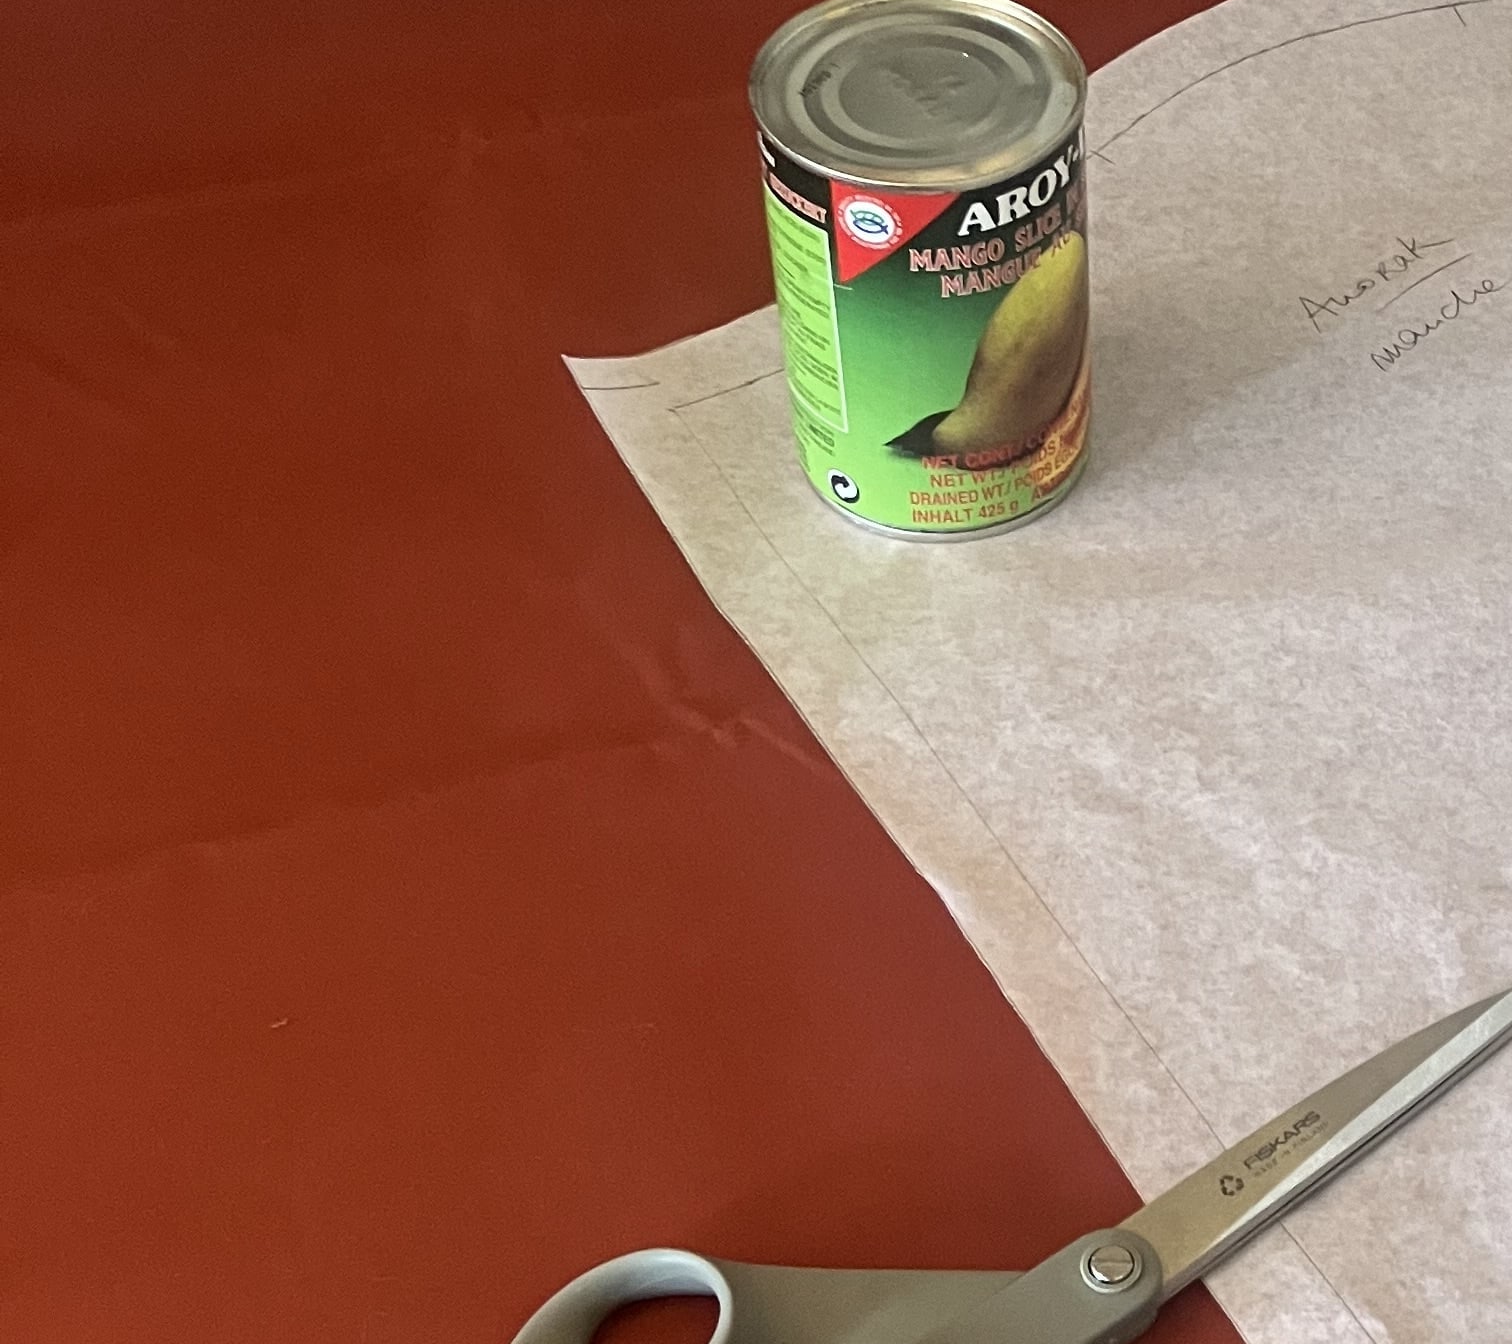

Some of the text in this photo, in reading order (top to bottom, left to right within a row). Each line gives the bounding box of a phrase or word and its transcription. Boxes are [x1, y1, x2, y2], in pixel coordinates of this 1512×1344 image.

[909, 237, 1005, 272] MANGO
[922, 455, 958, 470] NET
[930, 472, 967, 488] NET
[909, 489, 979, 506] DRAINED
[912, 508, 973, 524] INHALT
[977, 502, 1006, 519] 425
[1243, 1110, 1321, 1170] FISKARS
